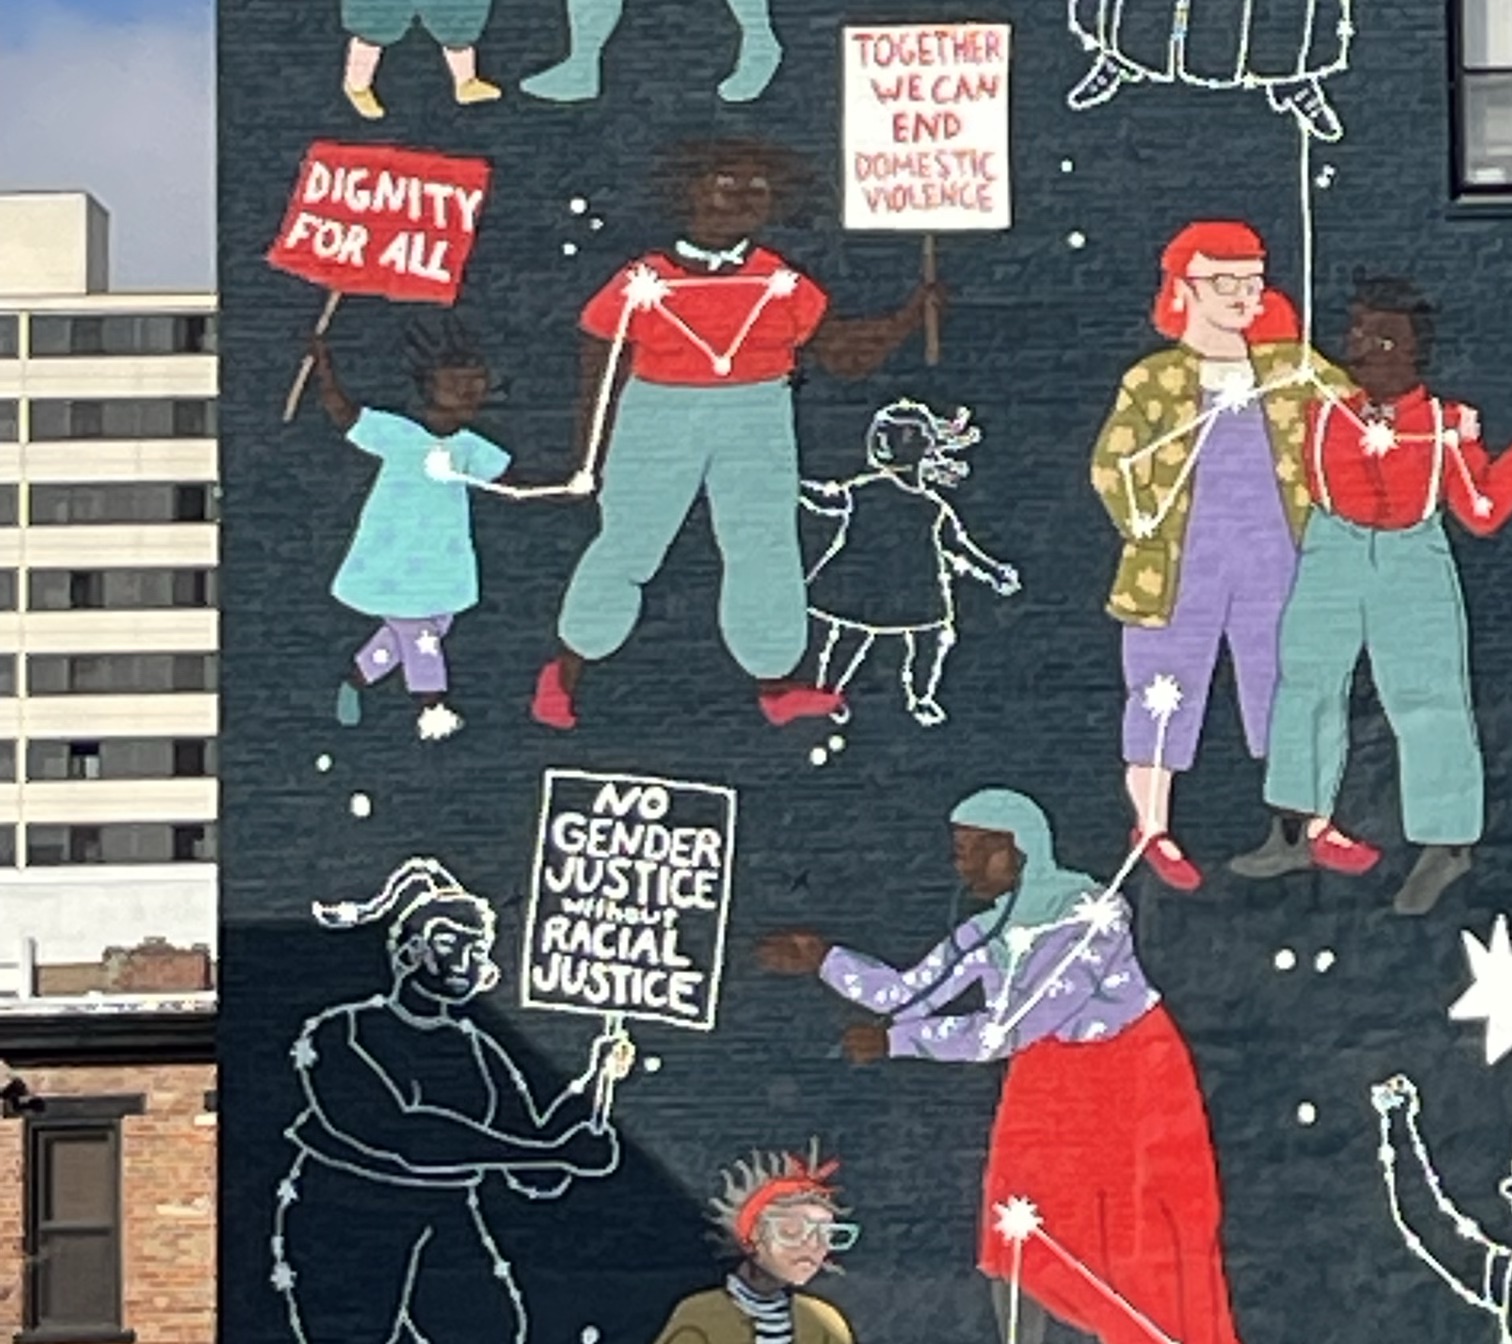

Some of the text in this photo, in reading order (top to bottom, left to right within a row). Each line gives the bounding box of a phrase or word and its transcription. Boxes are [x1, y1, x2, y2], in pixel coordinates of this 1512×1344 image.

[852, 31, 1003, 68] TOGETHER
[871, 74, 999, 104] WE CAN
[893, 111, 962, 143] END
[855, 149, 997, 182] DOMESTIC
[303, 161, 483, 233] DIGNITY
[862, 181, 994, 213] VIOLENCE
[285, 211, 451, 283] FOR ALL
[592, 782, 670, 820] NO
[552, 812, 721, 868] GENDER
[545, 856, 719, 909] JUSTICE
[541, 915, 692, 967] RACIAL
[532, 952, 703, 1016] JUSTICE
